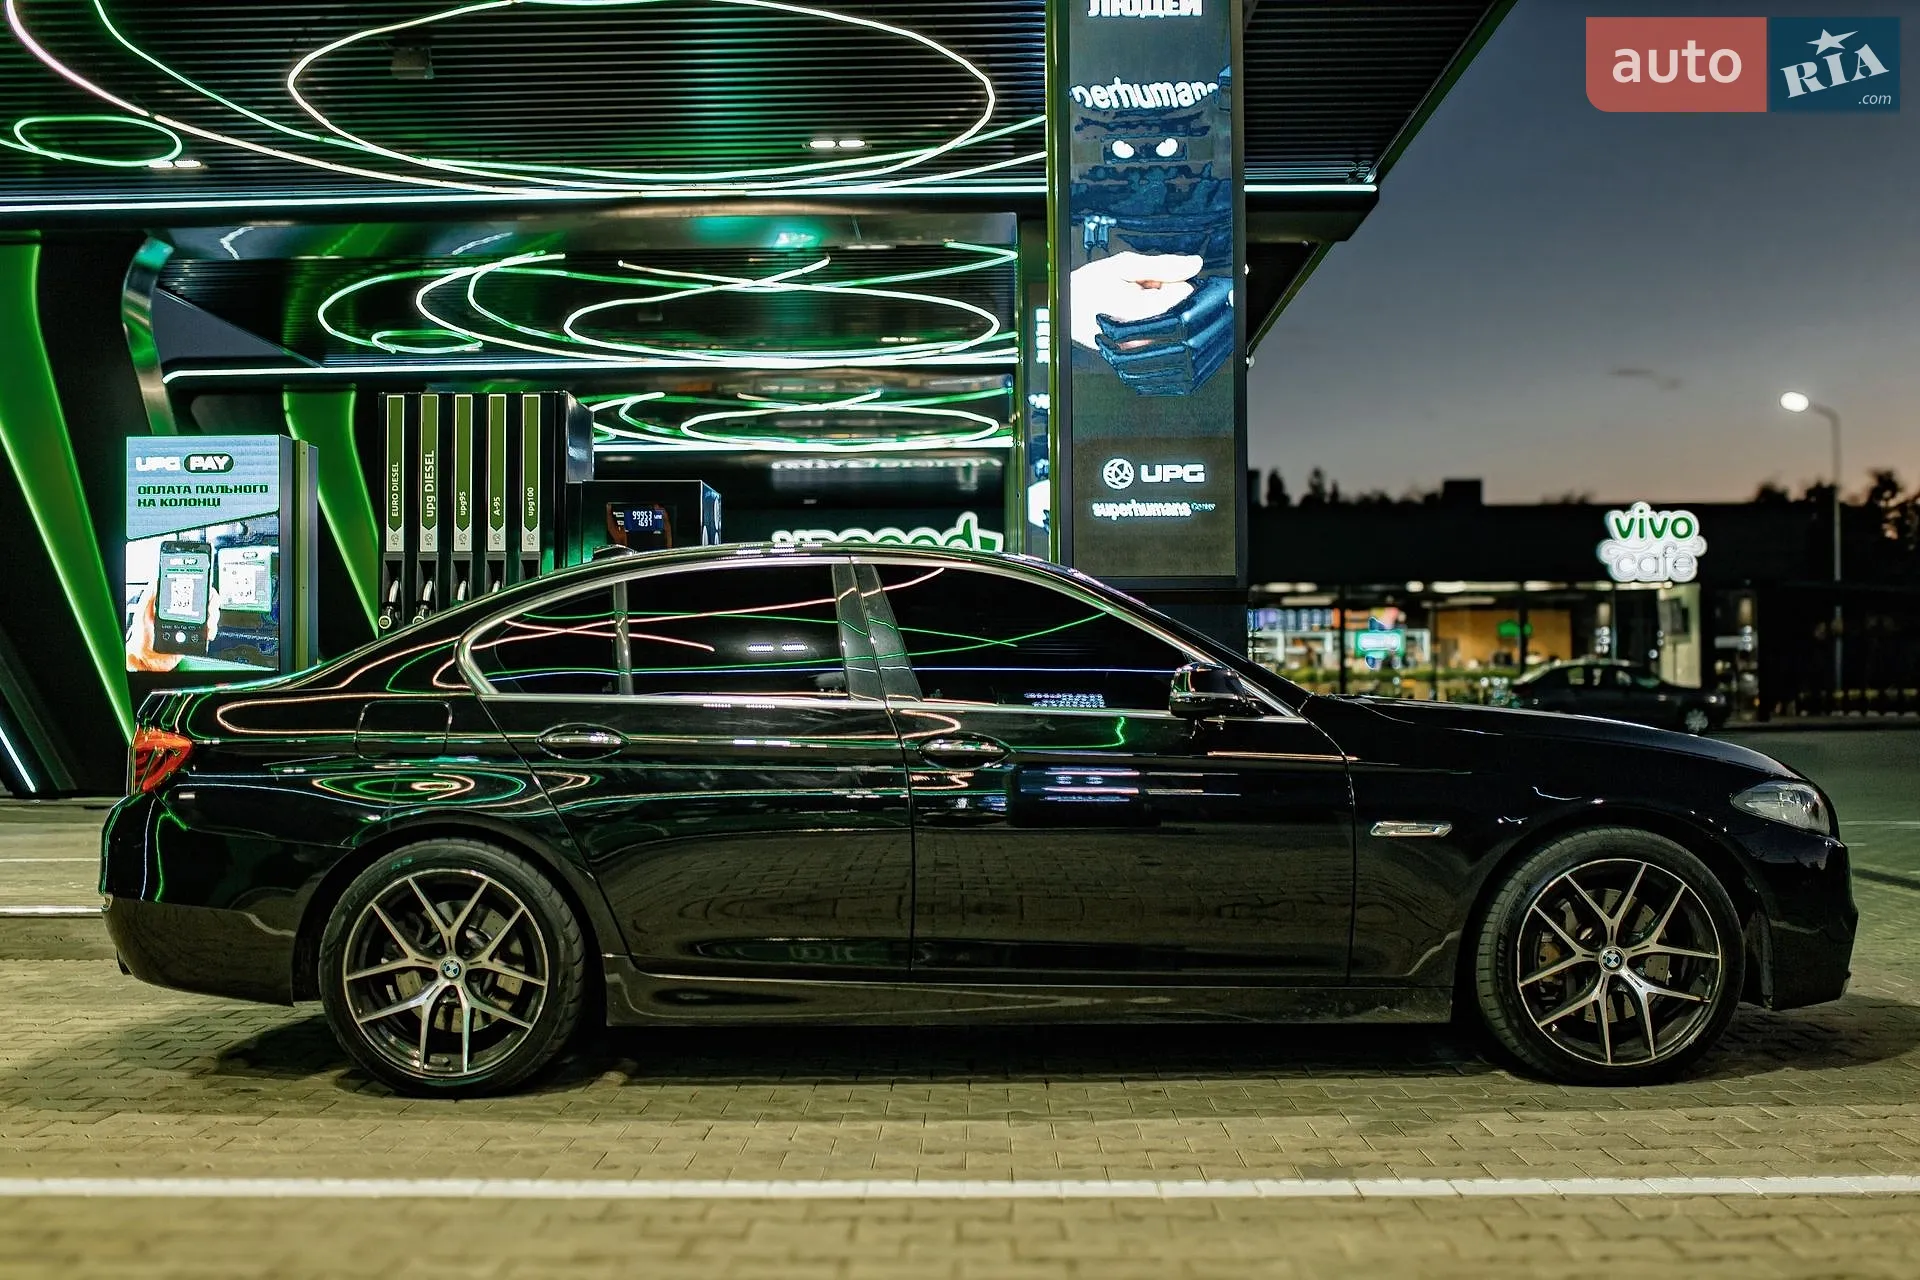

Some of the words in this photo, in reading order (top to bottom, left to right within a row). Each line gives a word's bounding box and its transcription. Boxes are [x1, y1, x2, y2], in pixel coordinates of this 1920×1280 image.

[189, 455, 230, 471] PAY
[425, 450, 435, 493] DIESEL
[1140, 464, 1206, 483] UPG
[391, 462, 399, 490] DIESEL
[137, 485, 192, 495] ОПЛАТА
[195, 484, 269, 494] ПАЛЬНОГО
[137, 498, 157, 507] НА
[160, 497, 221, 507] КОЛОНЦІ
[391, 493, 399, 517] EURO
[426, 495, 436, 517] upg
[459, 491, 468, 516] upg95
[493, 496, 501, 516] A-95
[527, 487, 536, 517] upg100
[1615, 508, 1694, 539] vivo
